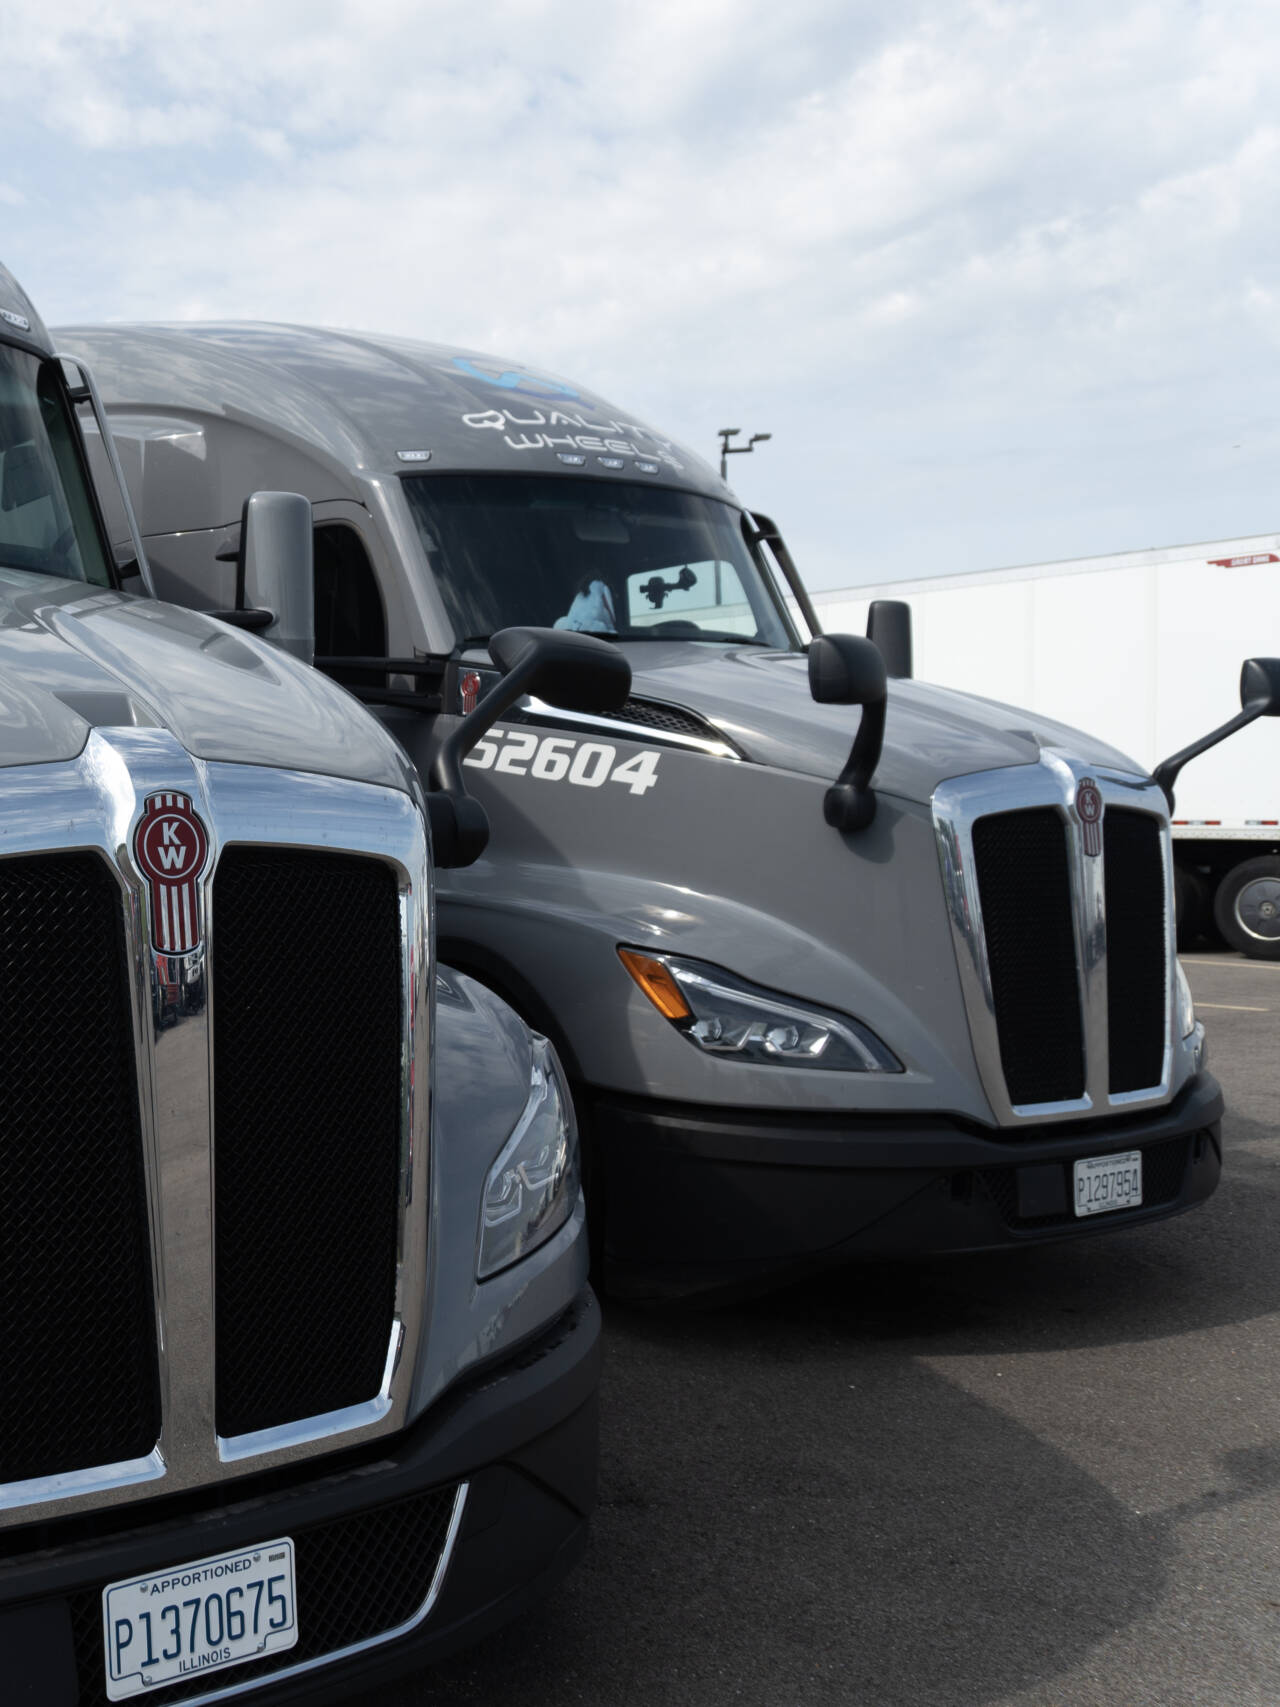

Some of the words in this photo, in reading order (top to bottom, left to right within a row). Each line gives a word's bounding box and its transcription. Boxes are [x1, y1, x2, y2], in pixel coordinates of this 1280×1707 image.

[462, 728, 661, 796] 52604
[1078, 1168, 1139, 1204] P1297954
[149, 1557, 253, 1597] APPORTIONED
[114, 1573, 288, 1675] P1370675
[178, 1647, 231, 1673] ILLINOIS
